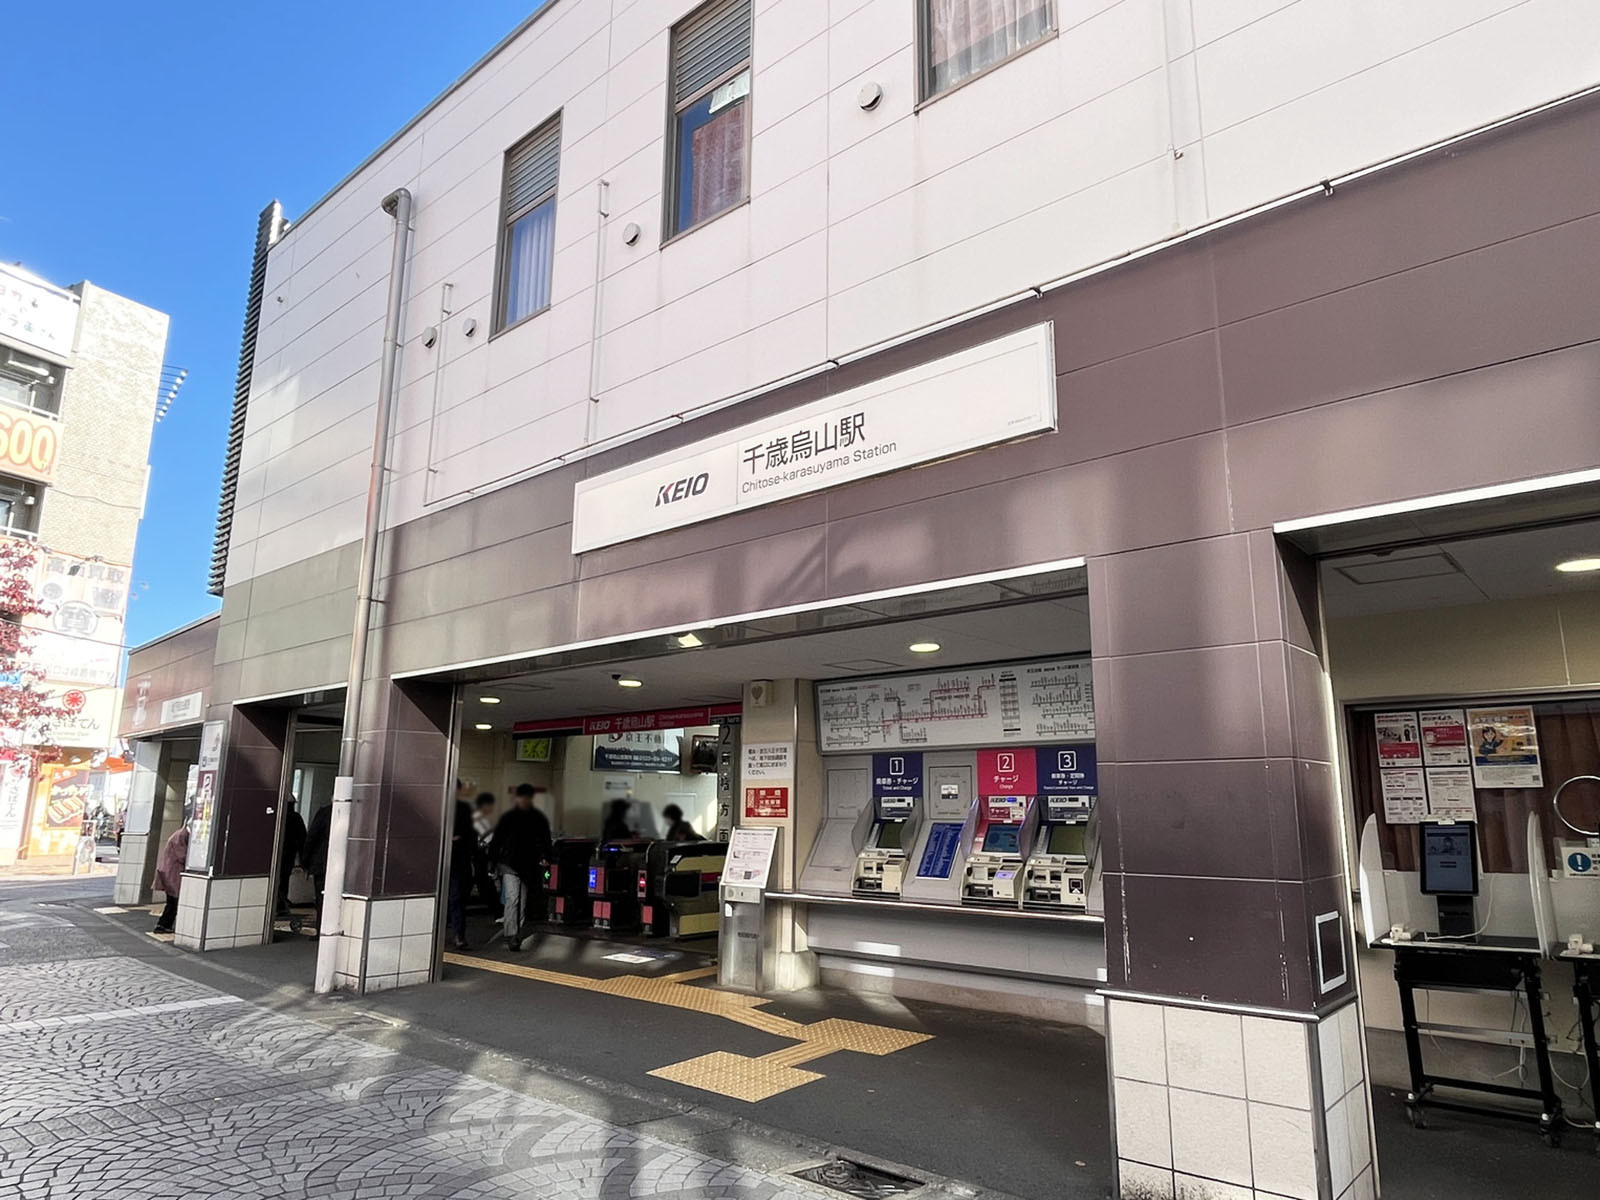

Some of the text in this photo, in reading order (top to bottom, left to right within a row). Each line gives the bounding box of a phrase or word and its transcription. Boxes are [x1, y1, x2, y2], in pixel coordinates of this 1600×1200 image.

[743, 412, 865, 475] 千歳烏山駅
[742, 441, 897, 494] Chitose-karasuyama Station
[655, 472, 709, 507] KEIO
[589, 721, 611, 731] KEIO
[1002, 755, 1011, 769] 2
[1063, 754, 1072, 768] 3
[993, 774, 1019, 783] チャージ
